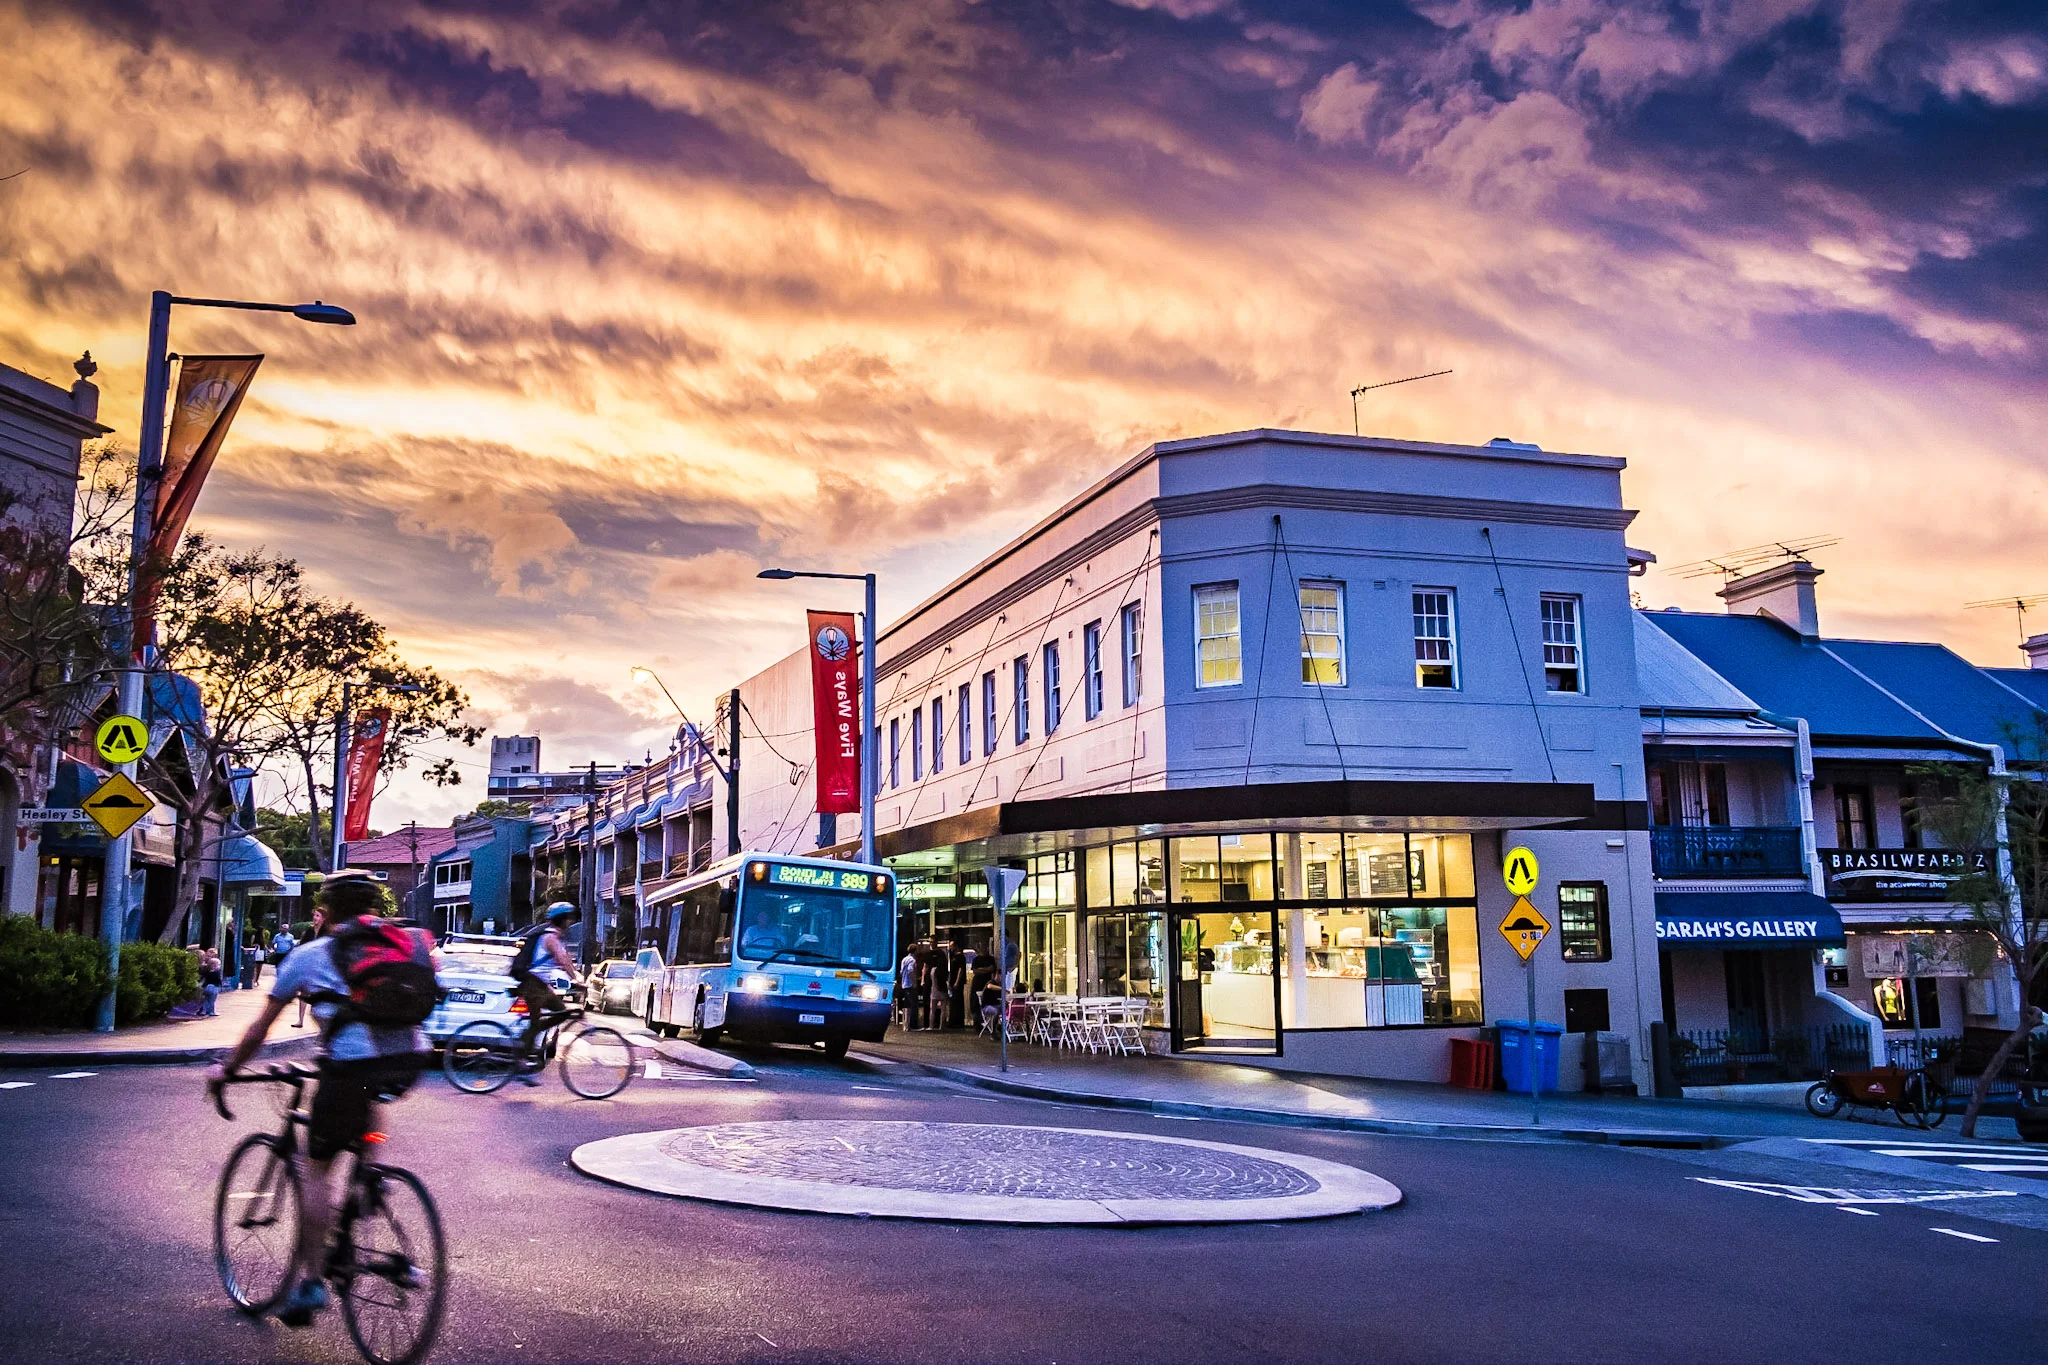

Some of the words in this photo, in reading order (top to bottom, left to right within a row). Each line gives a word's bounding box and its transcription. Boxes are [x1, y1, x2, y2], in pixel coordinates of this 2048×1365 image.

[352, 744, 365, 775] Ways
[349, 778, 359, 802] Five
[22, 809, 67, 821] Heeley
[72, 809, 86, 819] St
[780, 866, 817, 878] BONDI
[840, 872, 868, 890] 389
[1929, 881, 1948, 890] shop
[1656, 921, 1735, 938] SARAH'S
[1735, 921, 1817, 937] GALLERY
